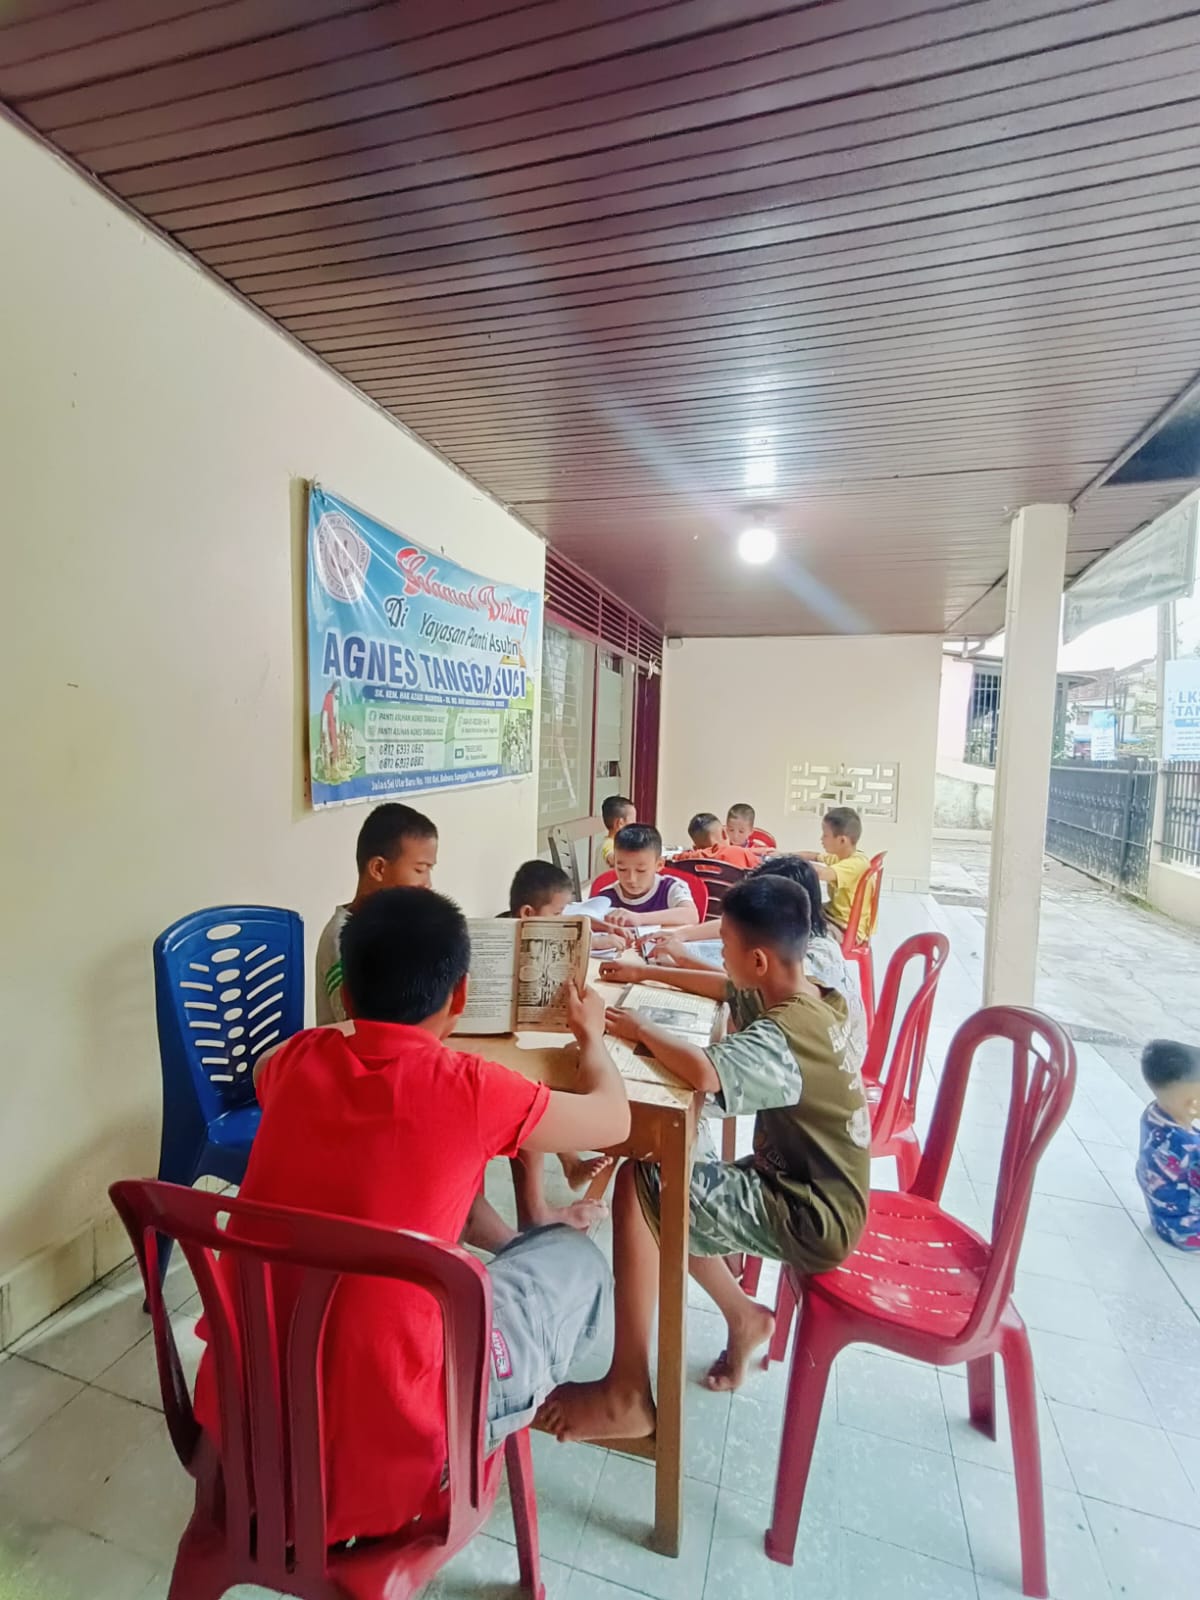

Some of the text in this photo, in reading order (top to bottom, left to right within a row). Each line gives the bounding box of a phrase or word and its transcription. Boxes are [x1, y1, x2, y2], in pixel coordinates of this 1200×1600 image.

[396, 548, 479, 612] Selamat
[385, 597, 408, 628] Di
[420, 612, 465, 645] Yayasan
[465, 627, 489, 650] Panti
[323, 632, 525, 698] AGNES TANGGA SUCI
